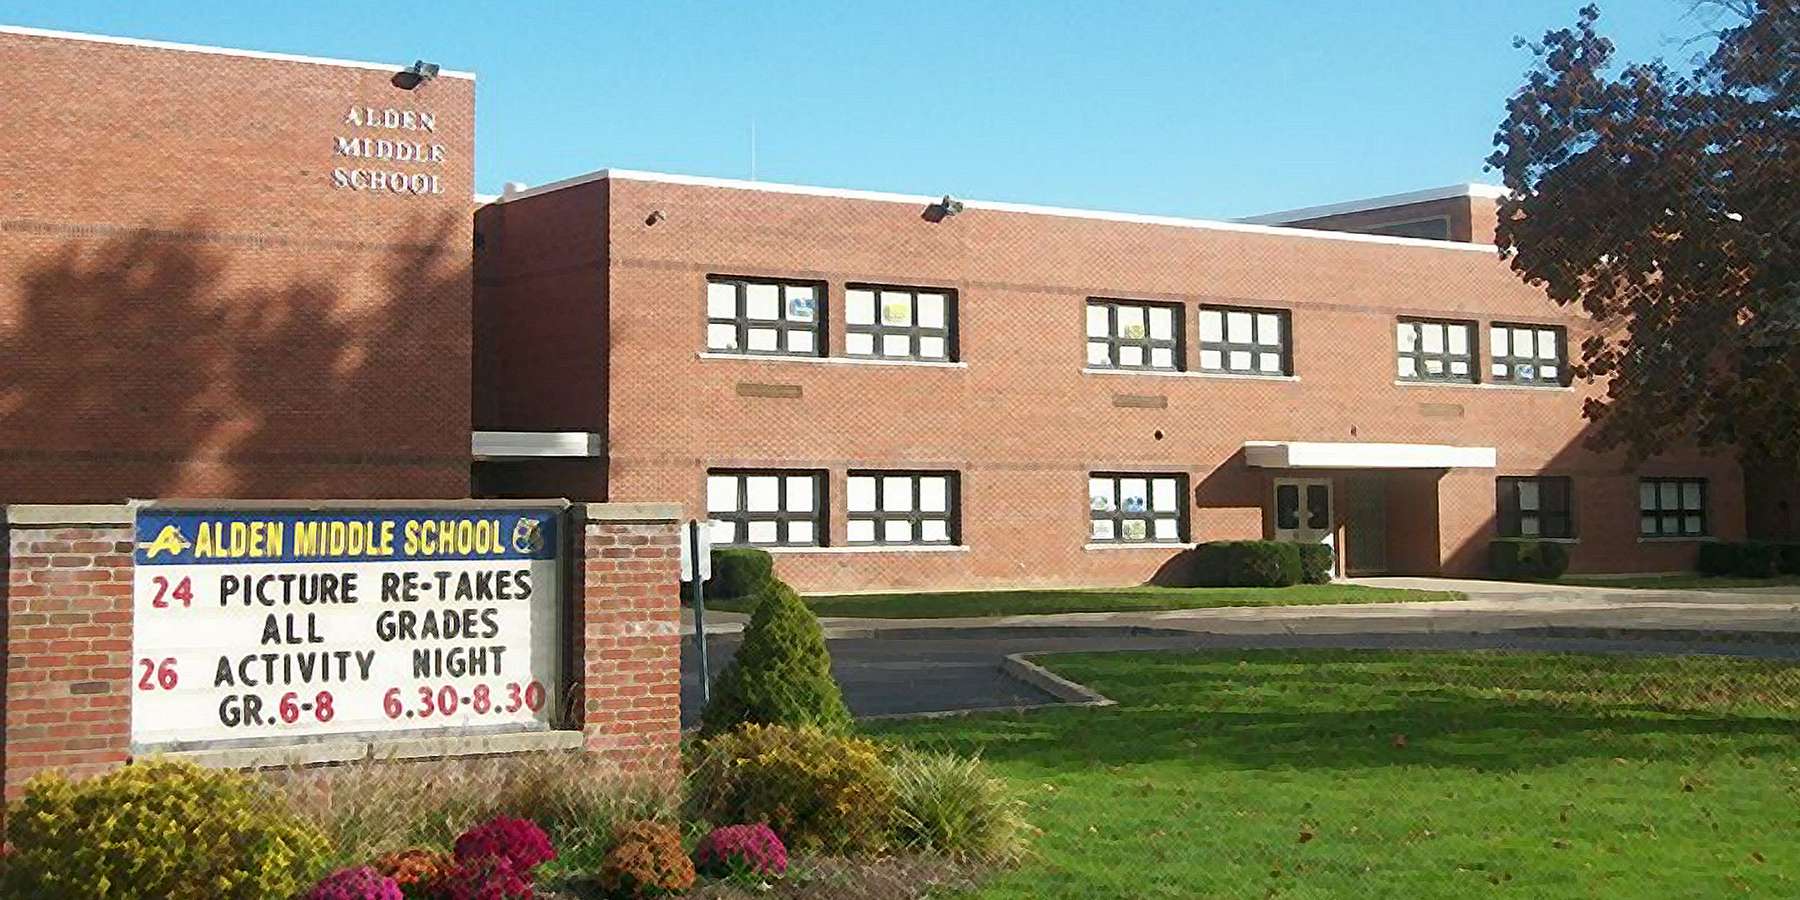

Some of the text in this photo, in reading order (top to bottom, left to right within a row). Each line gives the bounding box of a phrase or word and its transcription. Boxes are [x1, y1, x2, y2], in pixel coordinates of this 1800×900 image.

[344, 106, 436, 131] ALDEN
[334, 137, 446, 161] MIDDLE
[332, 167, 445, 194] SCHOOL
[194, 522, 284, 558] ALDEN
[294, 520, 395, 557] MIDDLE
[404, 519, 506, 556] SCHOOL
[152, 570, 532, 609] 24 PICTURE RE-TAKES
[261, 608, 499, 645] ALL GRADES
[138, 646, 507, 691] 26 ACTIVITY NIGHT
[383, 680, 546, 719] 6.30-8.30
